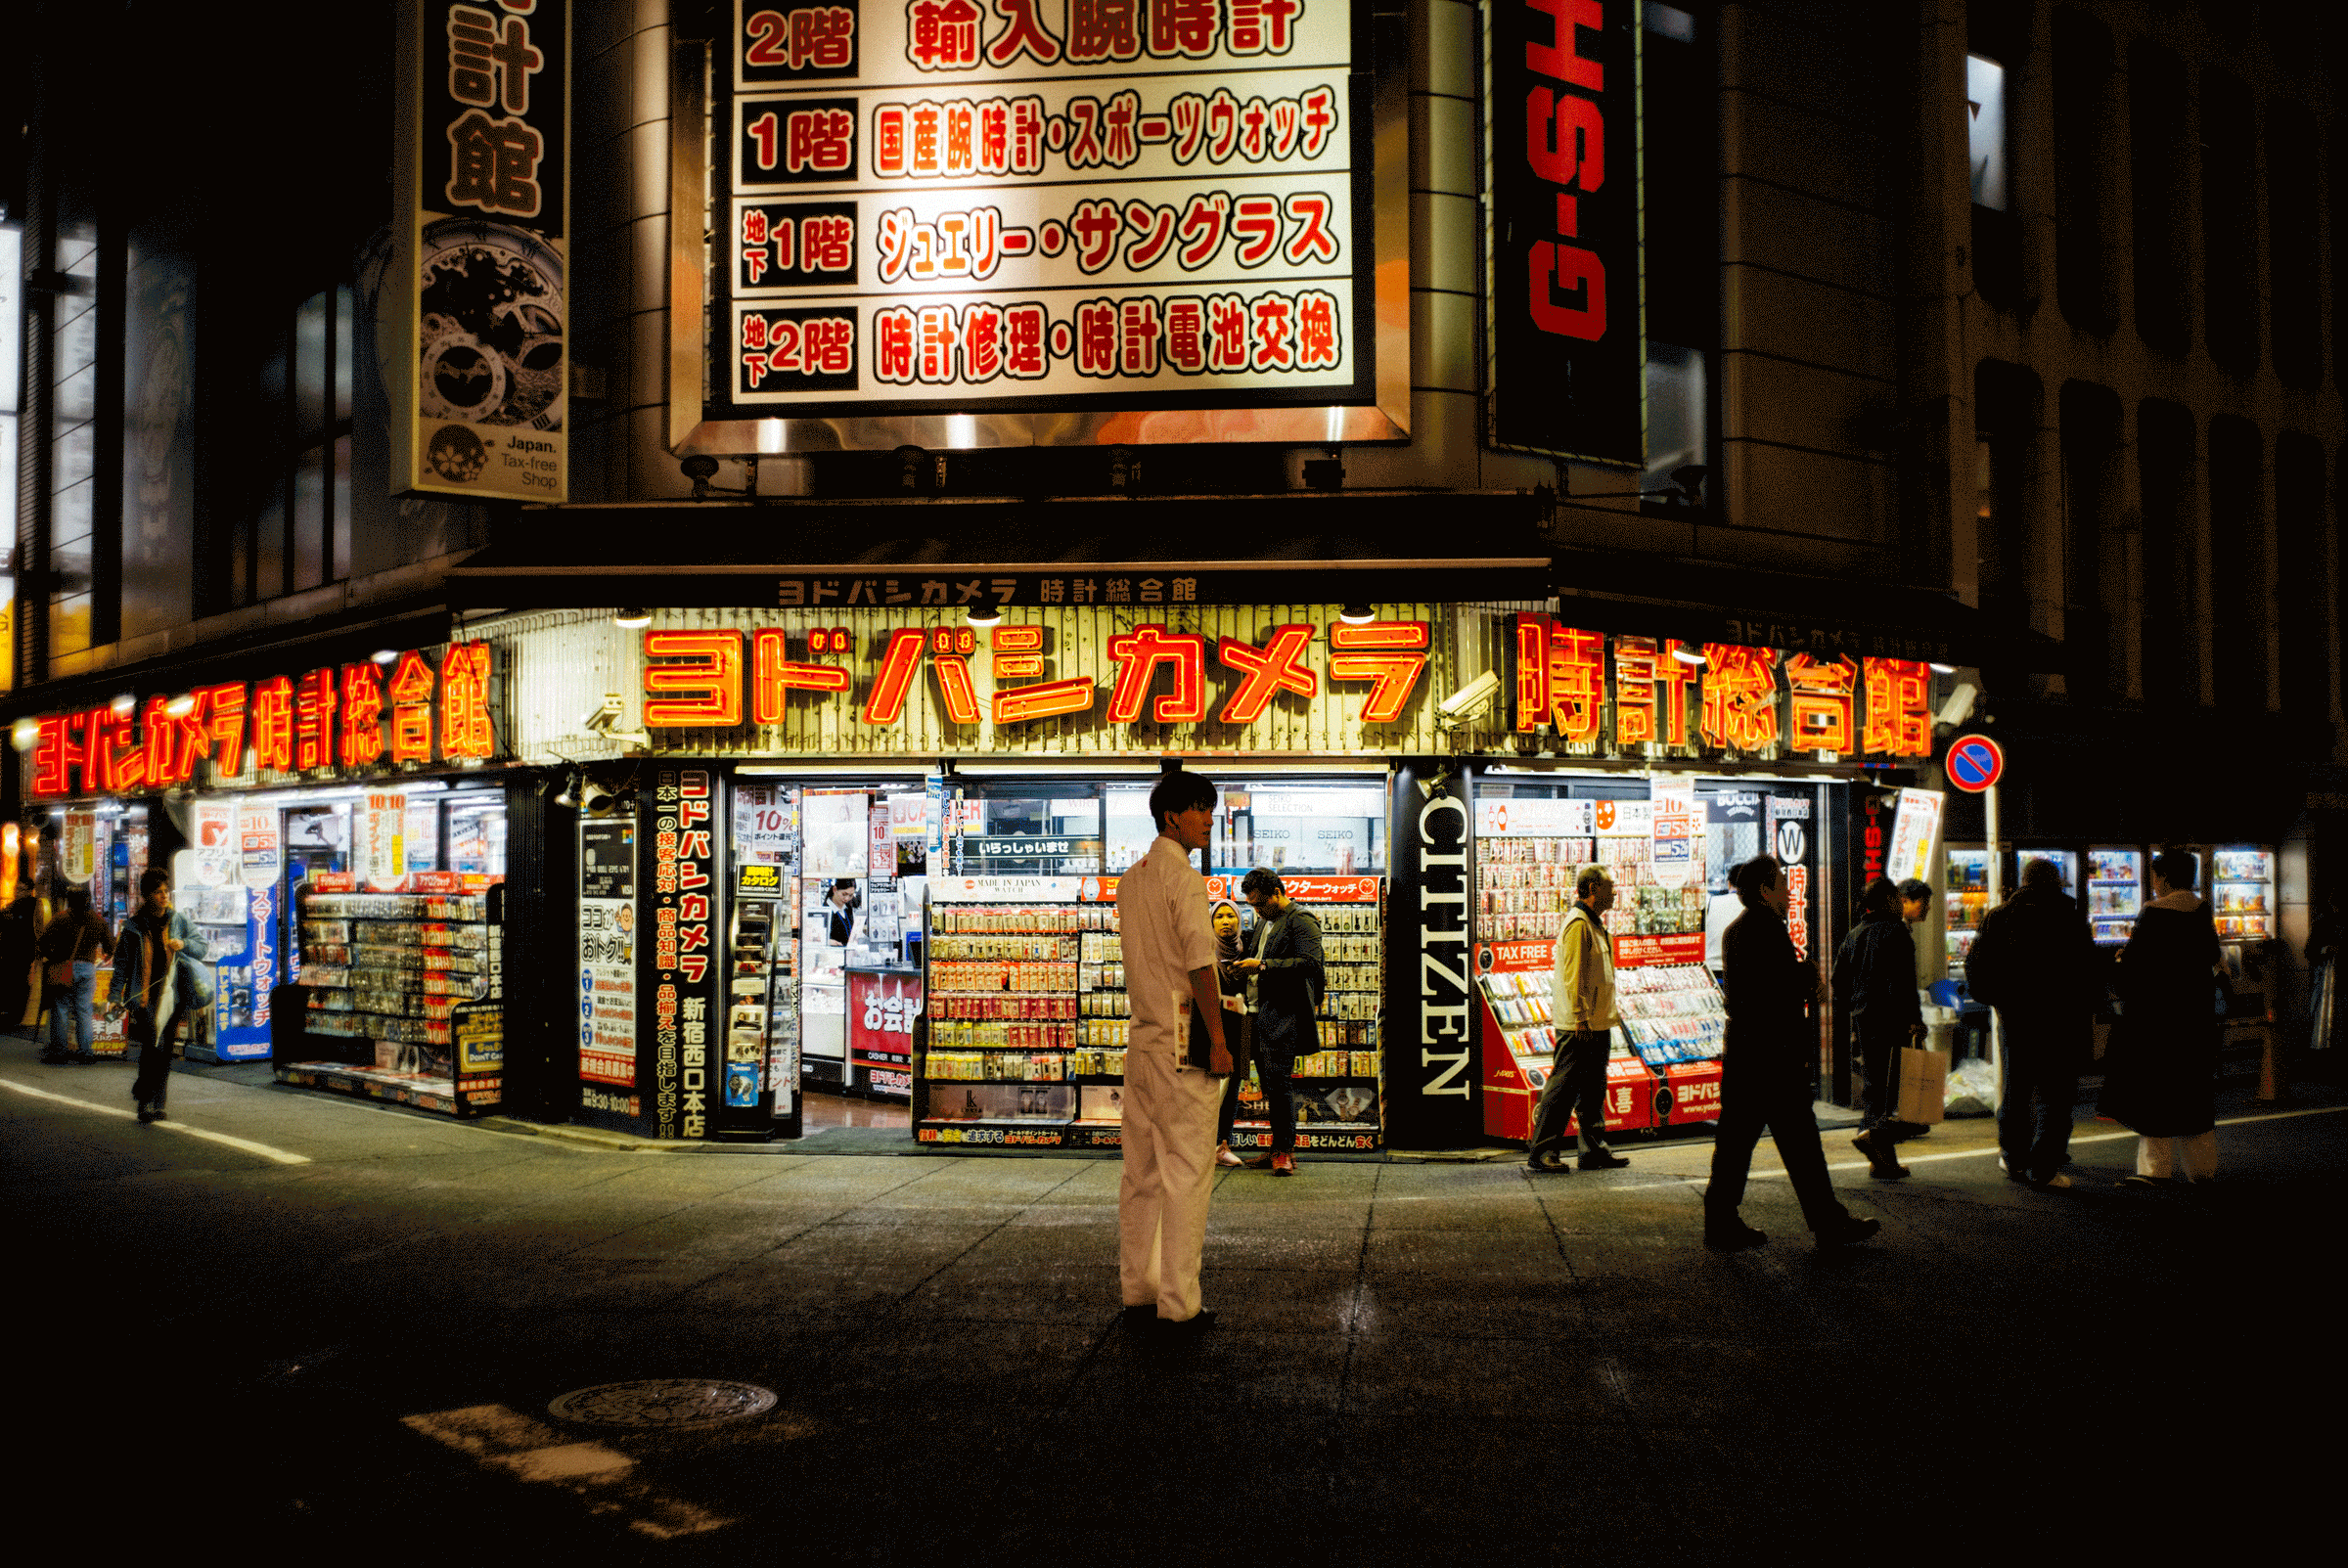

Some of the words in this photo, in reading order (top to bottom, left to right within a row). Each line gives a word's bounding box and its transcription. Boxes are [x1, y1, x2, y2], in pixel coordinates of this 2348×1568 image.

[745, 10, 854, 69] 2階
[908, 0, 1303, 70] 輸入腕時計
[445, 0, 545, 218] 計館
[749, 112, 853, 172] 1階
[873, 86, 1337, 176] 国産腕時計・スポーツウォッチ
[1526, 0, 1607, 342] G-SH
[743, 210, 768, 284] 地下
[773, 214, 854, 273] 1階
[878, 191, 1338, 283] ジュエリー・サングラス
[743, 315, 768, 388] 地下
[769, 318, 855, 375] 2階
[874, 291, 1341, 382] 時計修理・時計電池交換
[502, 453, 558, 471] Tax-free
[507, 435, 557, 453] Japan.
[522, 471, 558, 490] Shop
[779, 579, 1017, 605] ヨドバシカメラ
[1040, 578, 1197, 603] 時計総合館
[251, 639, 494, 774] 時計総合館
[643, 621, 1430, 728] ヨドバシカメラ
[1517, 612, 1932, 757] 時計総合館
[754, 832, 791, 841] ポイント還元
[979, 842, 1069, 855] いらっしゃいませ
[1253, 829, 1290, 839] SEIKO
[1318, 829, 1353, 840] SEIKO
[678, 770, 710, 983] ヨドバシカメラ
[741, 876, 779, 887] カタログ
[581, 904, 614, 931] ココが
[581, 932, 625, 963] おトク!!
[1418, 794, 1471, 1101] CITIZEN
[1787, 863, 1808, 963] 時計総
[251, 888, 273, 1028] スマートウォッチ
[1496, 946, 1519, 961] TAX
[1520, 944, 1548, 960] FREE
[864, 989, 921, 1034] お会計
[682, 996, 706, 1138] 新宿西口本店
[870, 1069, 912, 1088] ヨドバシカメ
